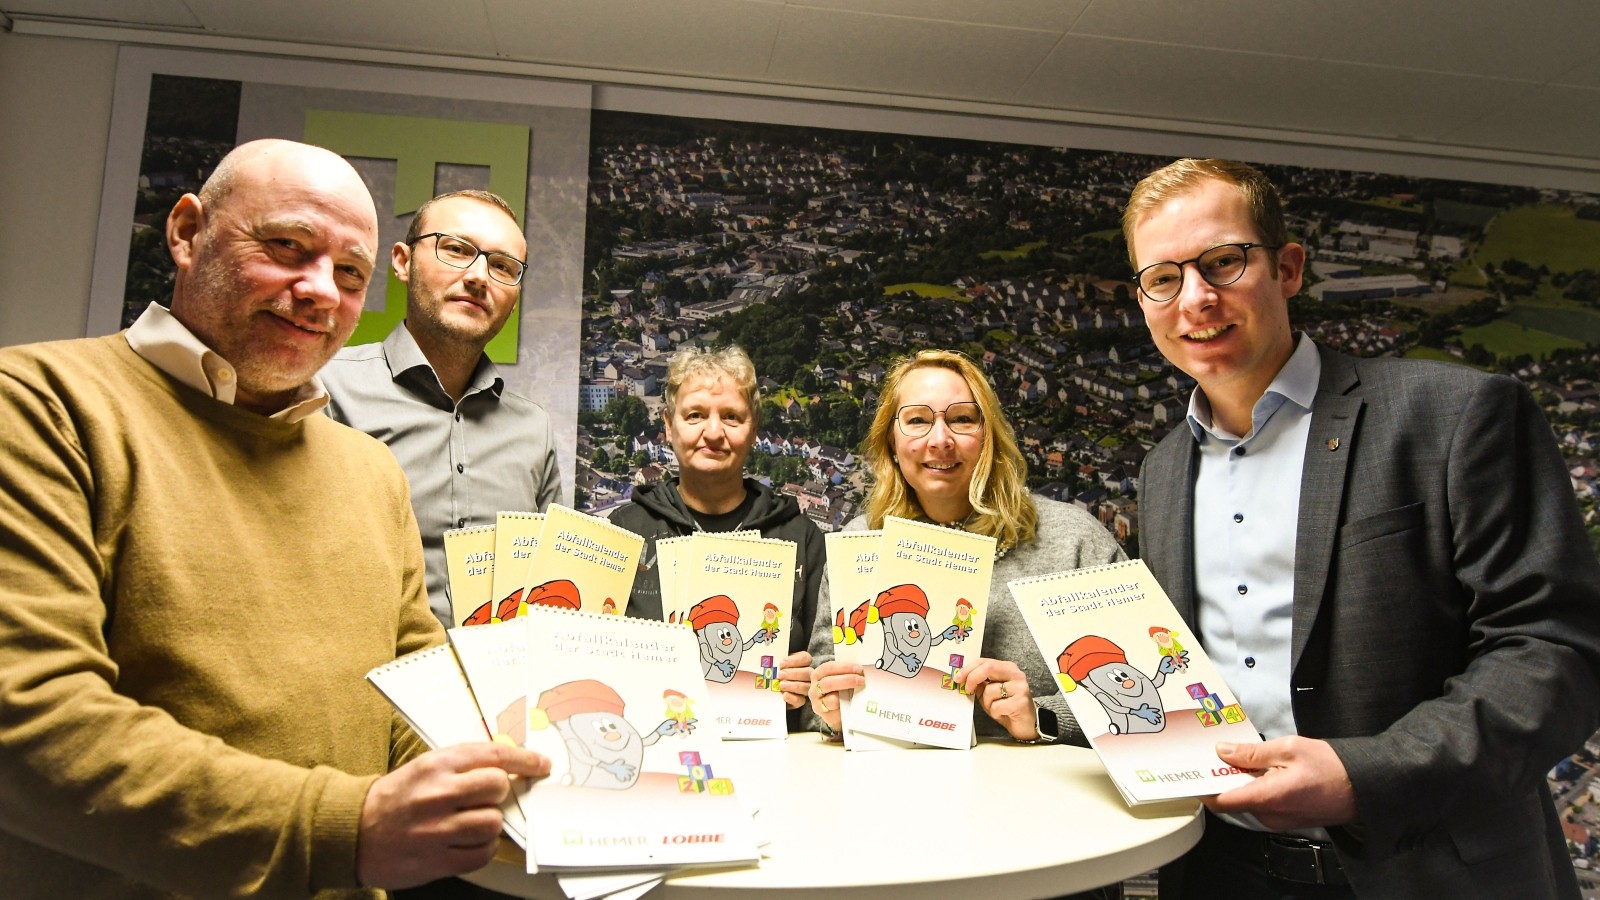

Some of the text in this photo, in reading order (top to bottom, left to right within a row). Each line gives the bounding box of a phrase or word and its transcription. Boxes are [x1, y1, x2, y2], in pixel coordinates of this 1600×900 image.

[513, 549, 532, 559] der
[557, 530, 629, 563] Abfallkalender
[897, 539, 980, 564] Abfallkalender
[555, 542, 626, 573] der Stadt Hemer
[704, 553, 783, 570] Abfallkalender
[896, 550, 978, 574] der Stadt Hemer
[468, 566, 488, 577] der
[704, 563, 781, 579] der Stadt Hemer
[857, 565, 874, 574] der
[1040, 582, 1140, 607] Abfallkalender
[1046, 593, 1146, 618] der Stadt Hemer
[738, 717, 772, 727] LOBBE
[878, 709, 957, 732] HEMER LOBBE
[1157, 766, 1256, 784] HEMER LOB
[662, 833, 726, 846] LOBBE
